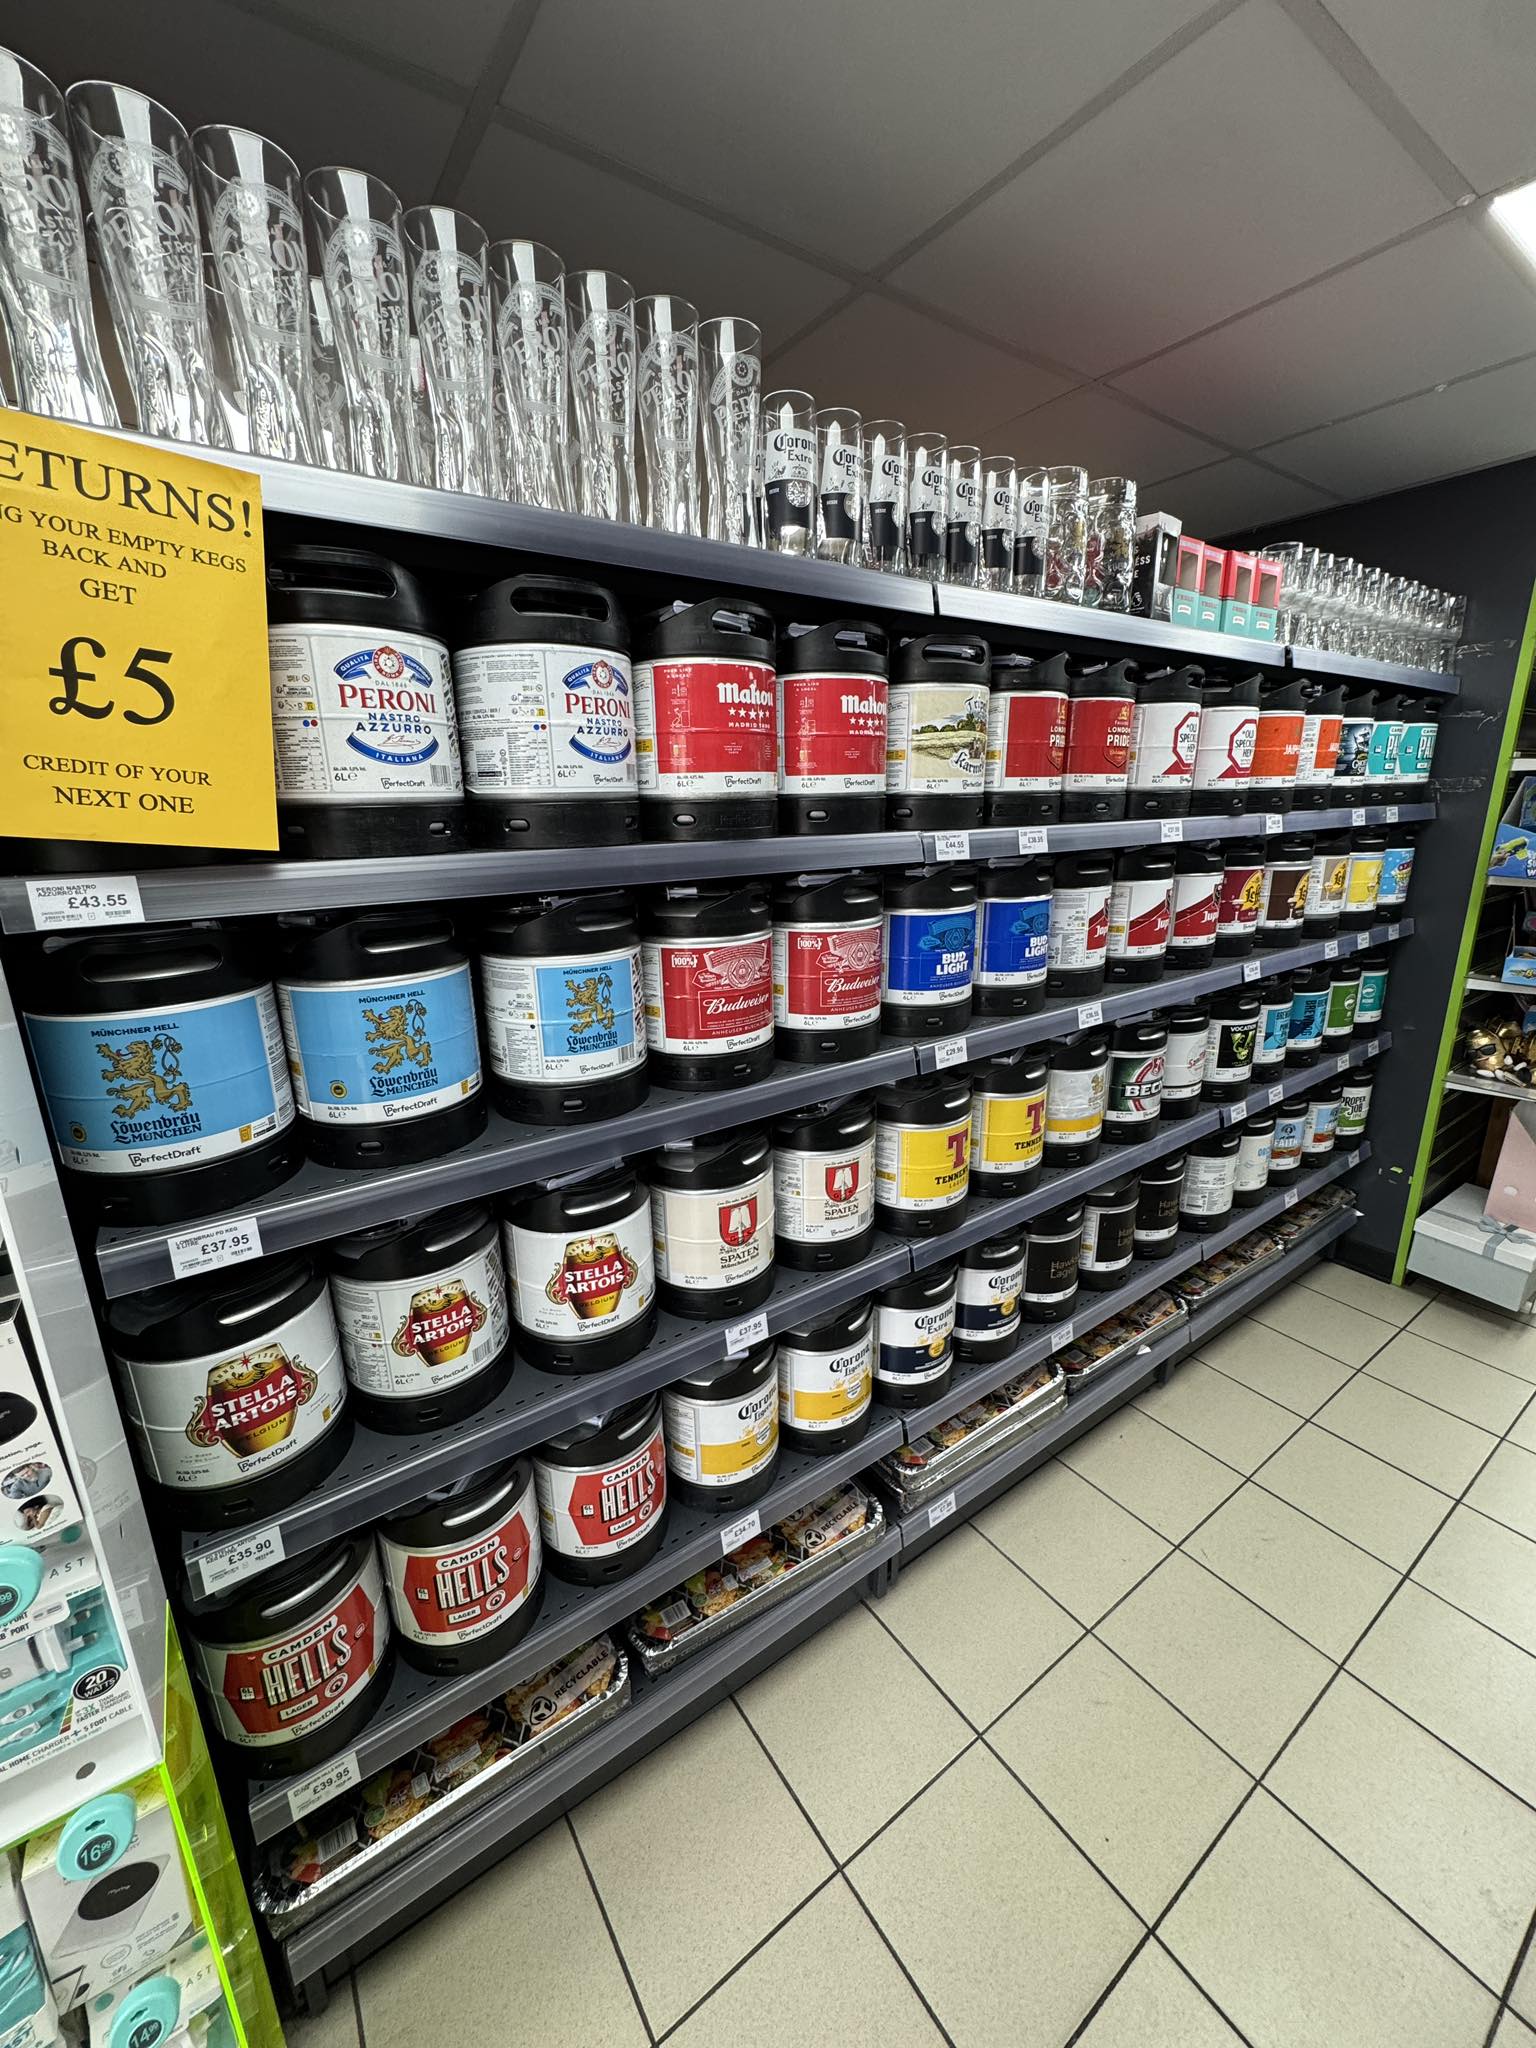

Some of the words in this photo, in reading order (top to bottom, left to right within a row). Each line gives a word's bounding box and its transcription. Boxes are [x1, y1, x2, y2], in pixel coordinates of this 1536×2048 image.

[787, 450, 813, 465] Extra
[35, 512, 103, 541] YOUR
[107, 527, 186, 559] EMPTY
[191, 545, 248, 574] KEGS
[42, 538, 111, 569] BACK
[118, 554, 168, 580] AND
[80, 577, 137, 606] GET
[48, 635, 176, 726] £5
[338, 683, 438, 714] PERONI
[565, 692, 631, 720] PERONI
[356, 721, 432, 735] AZZURRO
[368, 712, 421, 723] NASTRO
[586, 718, 622, 727] NASTRO
[576, 726, 629, 737] AZZURRO
[375, 752, 424, 763] ITALIANA
[590, 752, 623, 762] ITALIANA
[23, 753, 109, 778] CREDIT
[115, 761, 144, 779] OF
[150, 764, 213, 787] YOUR
[381, 778, 425, 790] PerfectDraft
[52, 785, 132, 811] NEXT
[138, 792, 195, 815] ONE
[68, 895, 128, 909] £43.55
[1029, 934, 1048, 947] BUD
[936, 960, 969, 976] LIGHT
[942, 951, 966, 965] BUD
[824, 975, 880, 993] Budweiser
[358, 993, 405, 1005] MÜNCHNER
[407, 989, 426, 998] HELL
[703, 993, 770, 1015] Budweiser
[91, 1026, 151, 1038] MÜNCHNER
[153, 1023, 180, 1033] HELL
[566, 1031, 618, 1053] Löwenbräu
[726, 1035, 761, 1050] PerfectDraft
[369, 1068, 438, 1097] Löwenbräu
[383, 1096, 438, 1118] PerfectDraft
[1027, 1099, 1045, 1136] T
[1347, 1103, 1363, 1116] JOB
[110, 1111, 201, 1144] Löwenbräu
[128, 1145, 201, 1167] PerfectDraft
[948, 1128, 968, 1169] T
[824, 1203, 859, 1216] SPATEN
[202, 1234, 250, 1256] £37.95
[720, 1244, 760, 1264] SPATEN
[564, 1260, 623, 1282] STELLA
[725, 1266, 759, 1284] PerfectDraft
[565, 1271, 625, 1294] ARTOIS
[1000, 1280, 1020, 1294] Extra
[411, 1305, 472, 1333] STELLA
[413, 1315, 473, 1345] ARTOIS
[577, 1314, 620, 1332] PerfectDraft
[739, 1320, 763, 1338] £37.95
[927, 1320, 948, 1336] Extra
[211, 1374, 295, 1417] STELLA
[214, 1386, 297, 1431] ARTOIS
[242, 1417, 287, 1442] ELGIUM
[238, 1438, 298, 1473] PerfectDraft
[606, 1455, 648, 1483] CAMDEN
[600, 1459, 657, 1522] HELLS
[612, 1518, 634, 1533] LAGER
[820, 1499, 860, 1532] RECYCLABLE
[616, 1523, 650, 1550] PerfectDraft
[733, 1520, 757, 1539] £34.70
[228, 1539, 272, 1565] £35.90
[440, 1540, 496, 1569] CAMDEN
[434, 1544, 512, 1609] HELLS
[452, 1608, 478, 1622] LAGER
[10, 1622, 30, 1636] PORT
[457, 1613, 503, 1640] PerfectDraft
[267, 1619, 334, 1661] CAMDEN
[261, 1623, 352, 1707] HELLS
[553, 1649, 610, 1699] RECYCLABLE
[84, 1677, 115, 1698] WATTS
[85, 1670, 107, 1690] 20
[76, 1708, 100, 1724] FASTER
[285, 1699, 314, 1717] LAGER
[291, 1699, 345, 1737] PerfectDraft
[8, 1754, 31, 1769] HOME
[32, 1733, 71, 1757] CHARGER
[90, 1717, 108, 1728] FOOT
[109, 1703, 134, 1720] CABLE
[312, 1766, 350, 1796] £39.95
